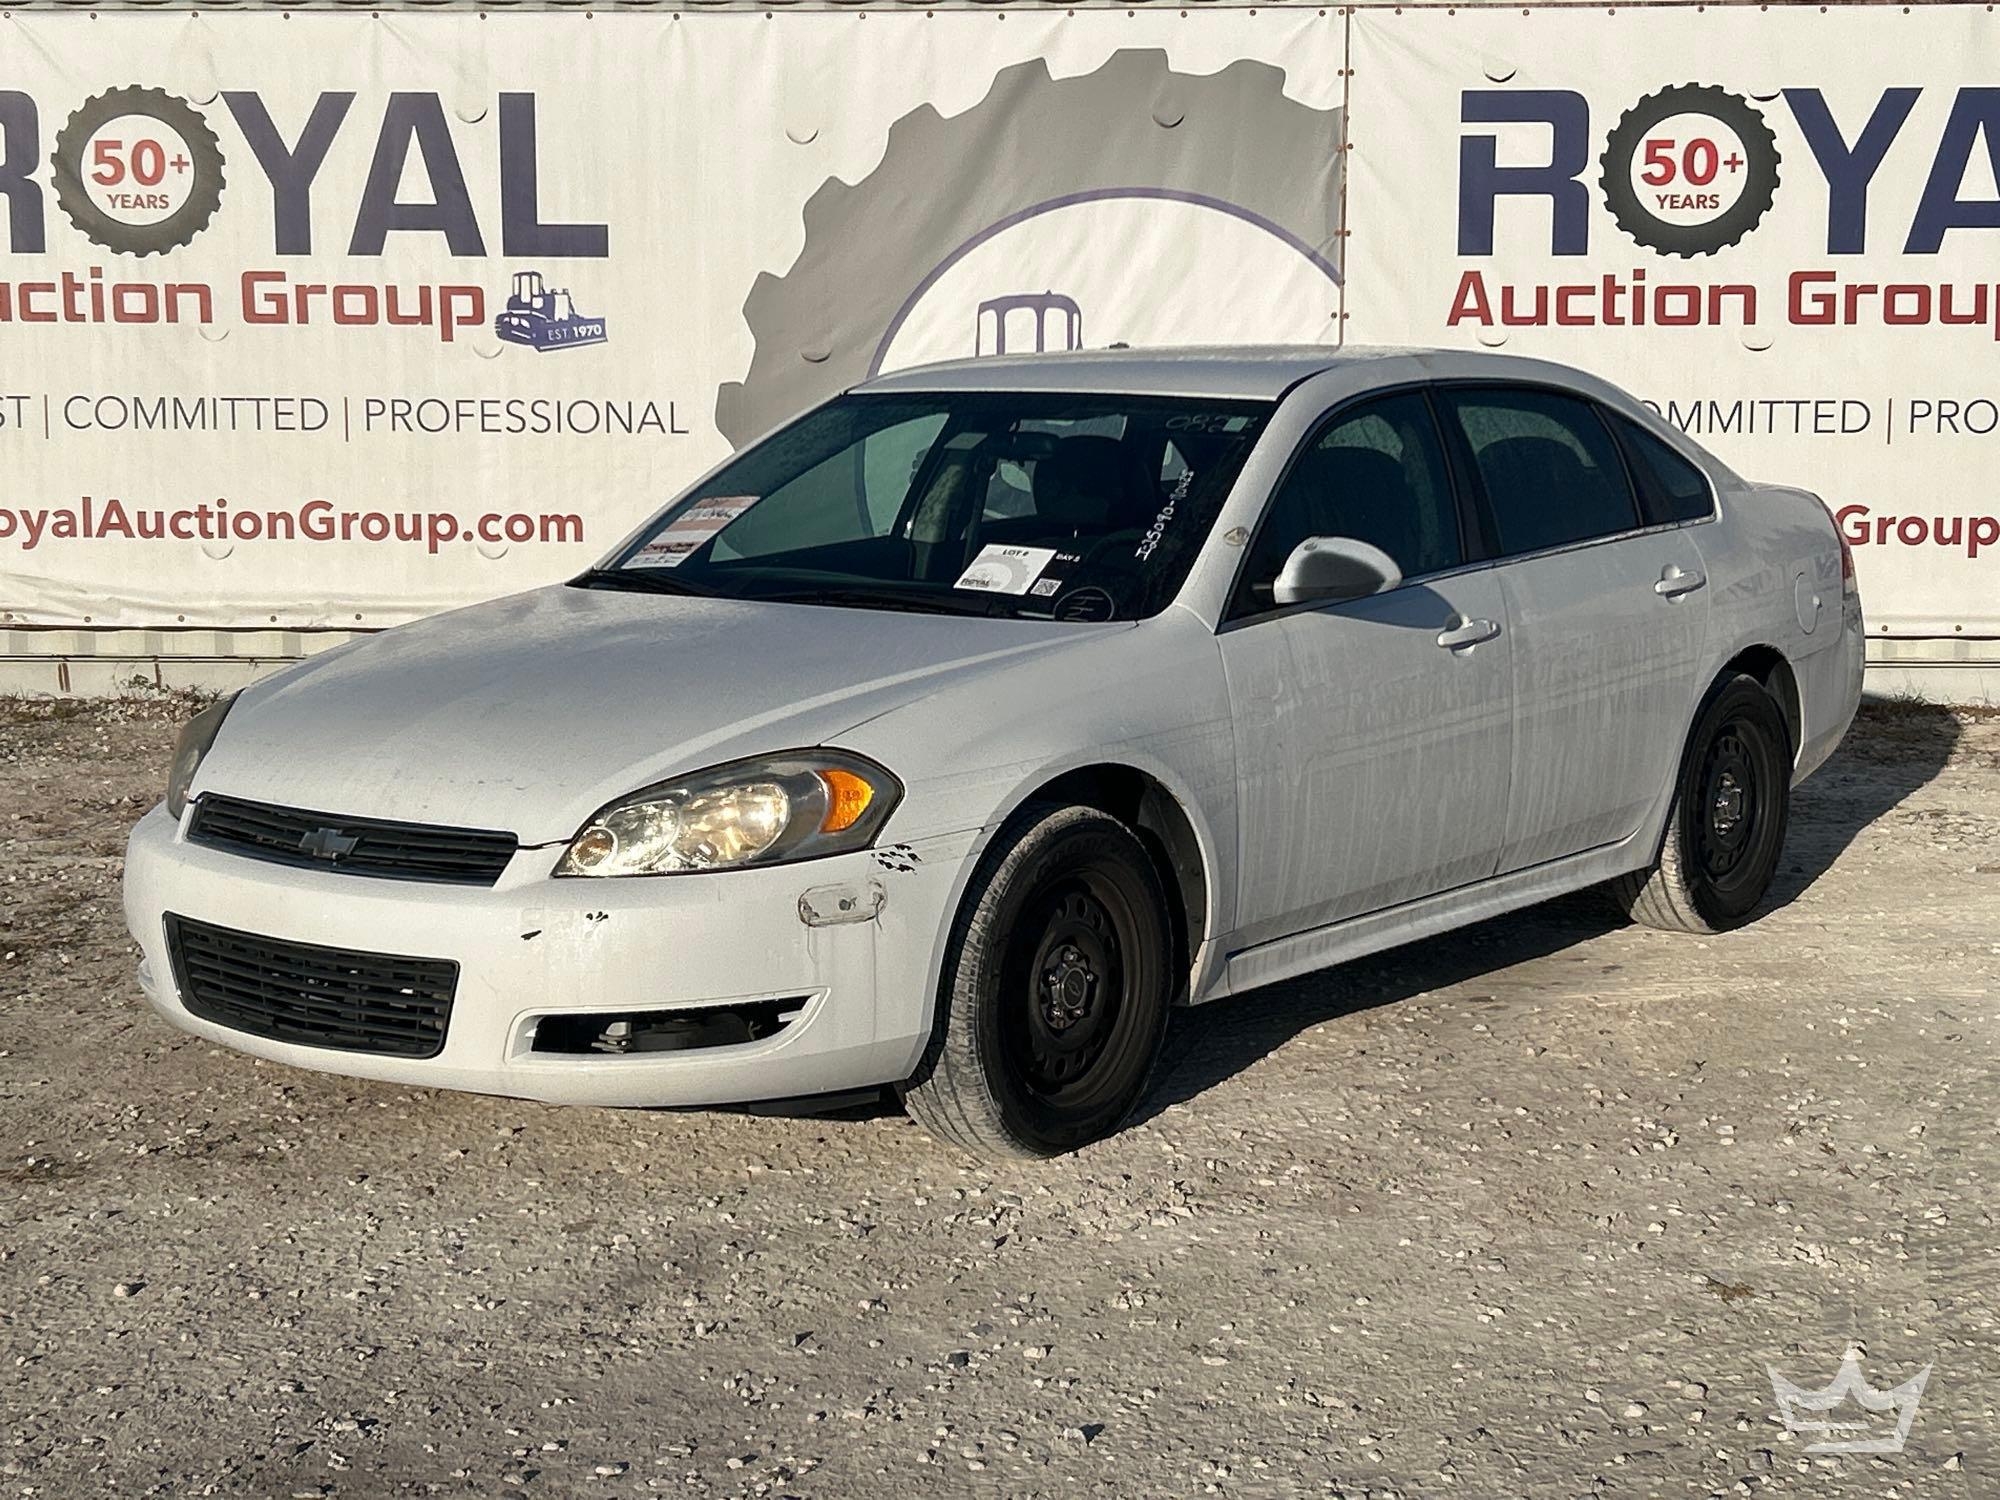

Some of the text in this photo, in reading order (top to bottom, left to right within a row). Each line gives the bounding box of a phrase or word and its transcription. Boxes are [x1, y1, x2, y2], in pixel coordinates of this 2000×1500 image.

[91, 138, 191, 188] 50+
[1640, 137, 1745, 188] 50+
[106, 192, 170, 211] YEARS
[1655, 193, 1720, 211] YEARS
[0, 266, 487, 342] ction Group
[1447, 268, 2000, 342] Auction Grou
[572, 323, 602, 338] 1970
[0, 395, 691, 436] T COMMITTED PROFESSIONAL
[1641, 399, 2000, 435] MMITTED PRO
